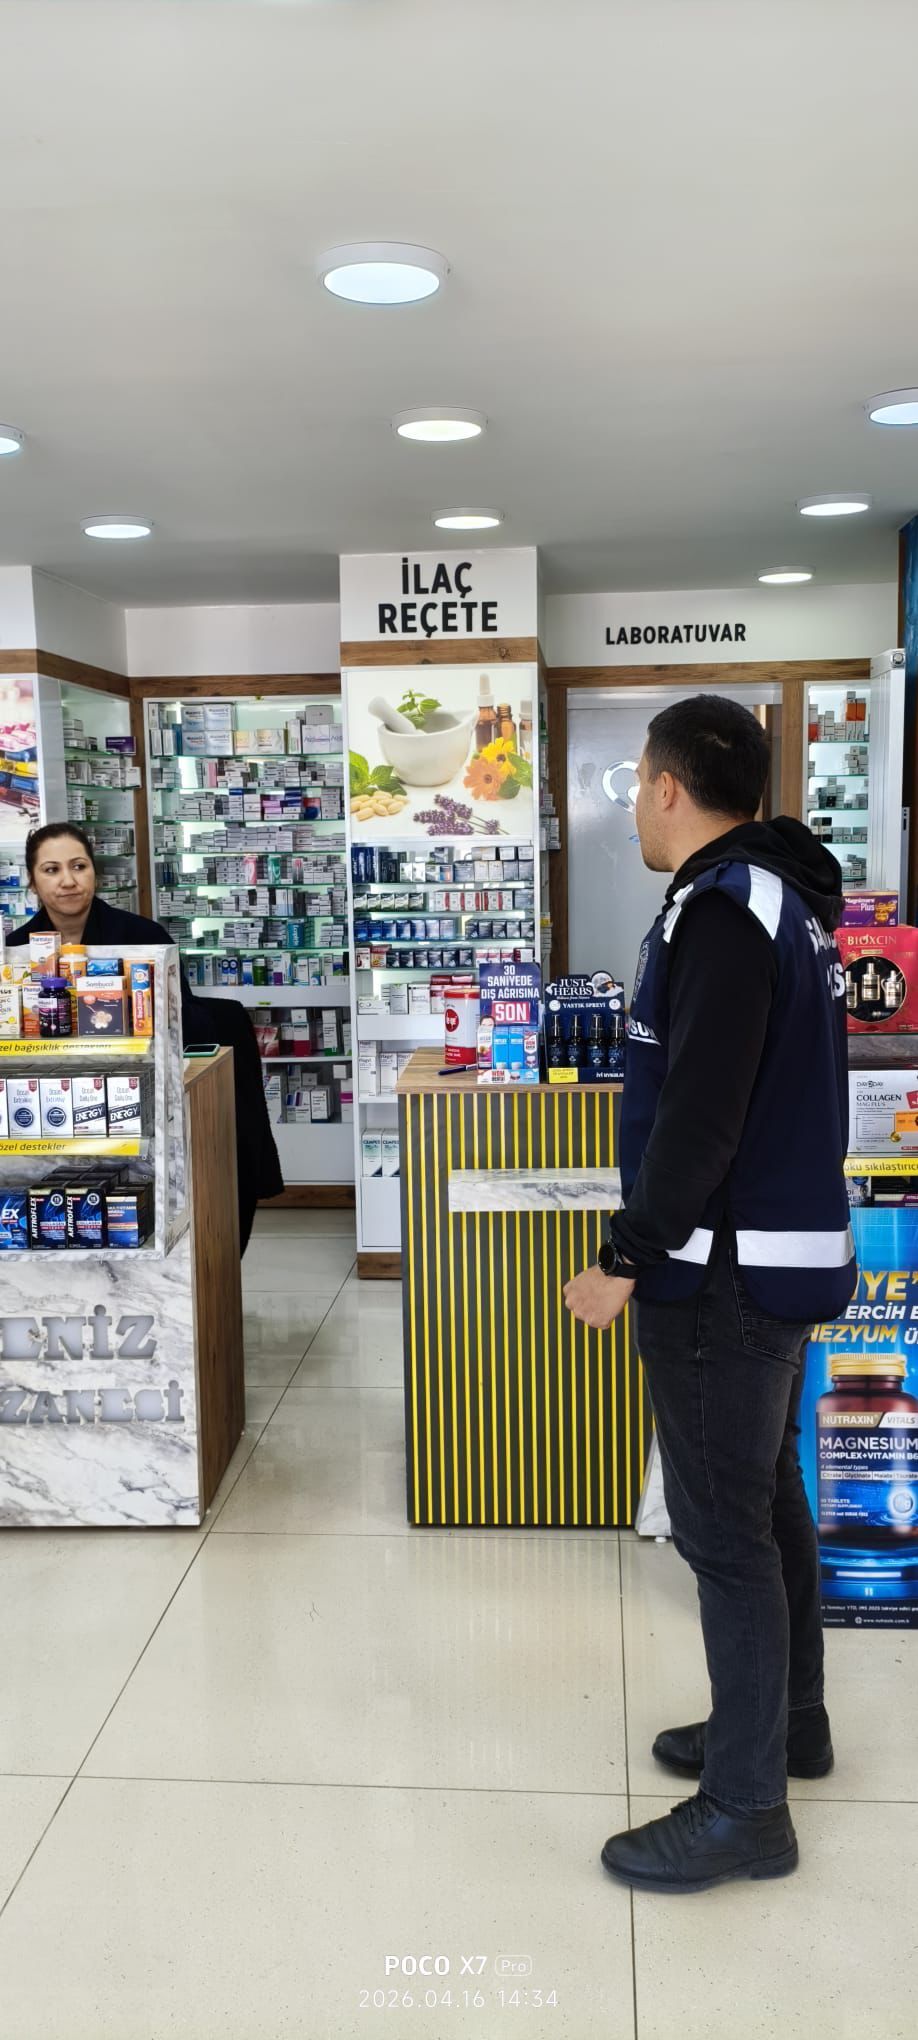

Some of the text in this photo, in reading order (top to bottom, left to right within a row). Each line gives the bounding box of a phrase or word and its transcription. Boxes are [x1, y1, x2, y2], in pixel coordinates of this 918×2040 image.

[402, 557, 473, 599] İLAÇ
[378, 602, 498, 638] REÇETE
[605, 623, 746, 645] LABORATUVAR
[860, 903, 875, 911] Plus
[847, 934, 897, 945] BIOXCIN
[503, 965, 516, 975] 30
[487, 975, 533, 987] SANİYEDE
[560, 978, 587, 987] JUST
[481, 987, 540, 1000] DİŞ AĞRISINA
[554, 987, 593, 996] HERBS
[495, 1003, 527, 1022] SON
[14, 1043, 60, 1053] bağışıklık
[75, 1107, 104, 1122] ENERGY
[110, 1106, 138, 1121] ENERGY
[19, 1142, 66, 1151] destekler
[30, 1197, 39, 1239] ARTROFLEX
[66, 1196, 75, 1238] ARTROFLEX
[838, 1302, 906, 1320] ERCİH
[904, 1327, 918, 1345] Ü
[822, 1415, 916, 1425] NUTRAXIN VITALS
[819, 1436, 918, 1450] MAGNESIUM
[819, 1451, 905, 1460] COMPLEX+VITAMIN
